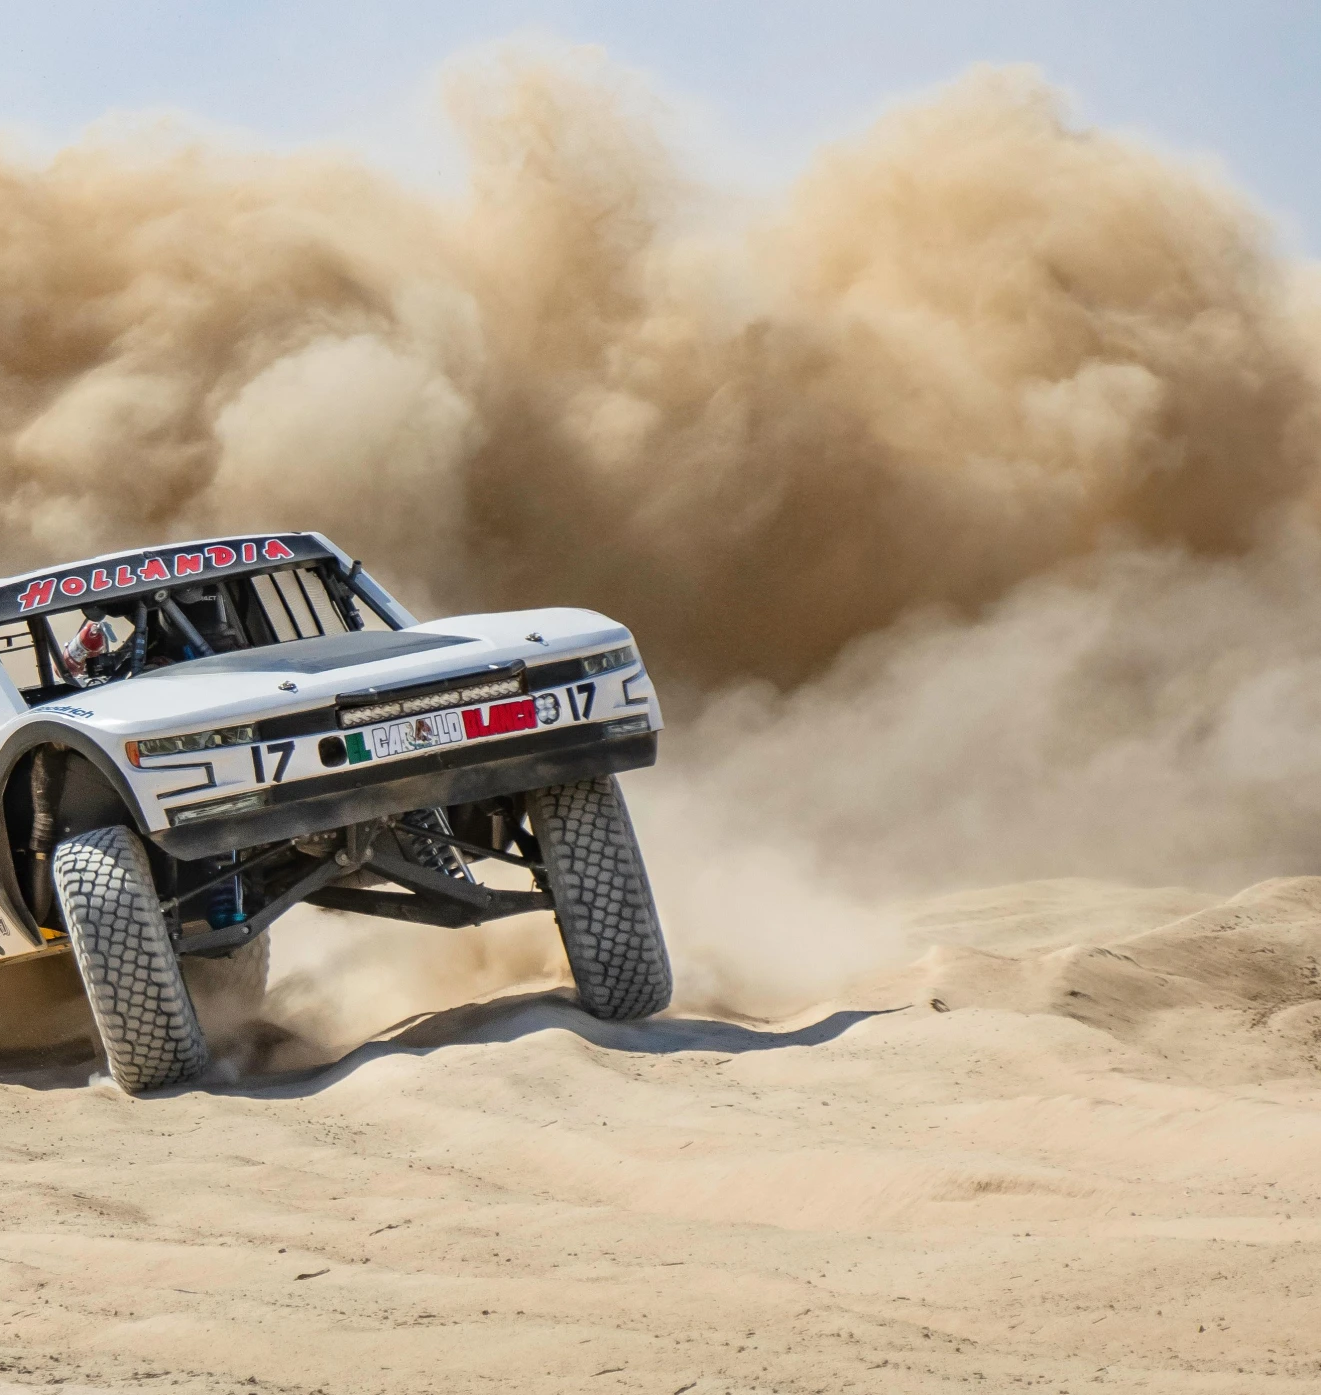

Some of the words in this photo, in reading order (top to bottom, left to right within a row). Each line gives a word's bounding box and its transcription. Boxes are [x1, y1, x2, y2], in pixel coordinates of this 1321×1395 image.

[18, 539, 294, 612] HOLLANDIA
[566, 682, 596, 721] 17
[344, 732, 372, 765] EL
[461, 699, 539, 740] BLANCO
[250, 740, 296, 784] 17
